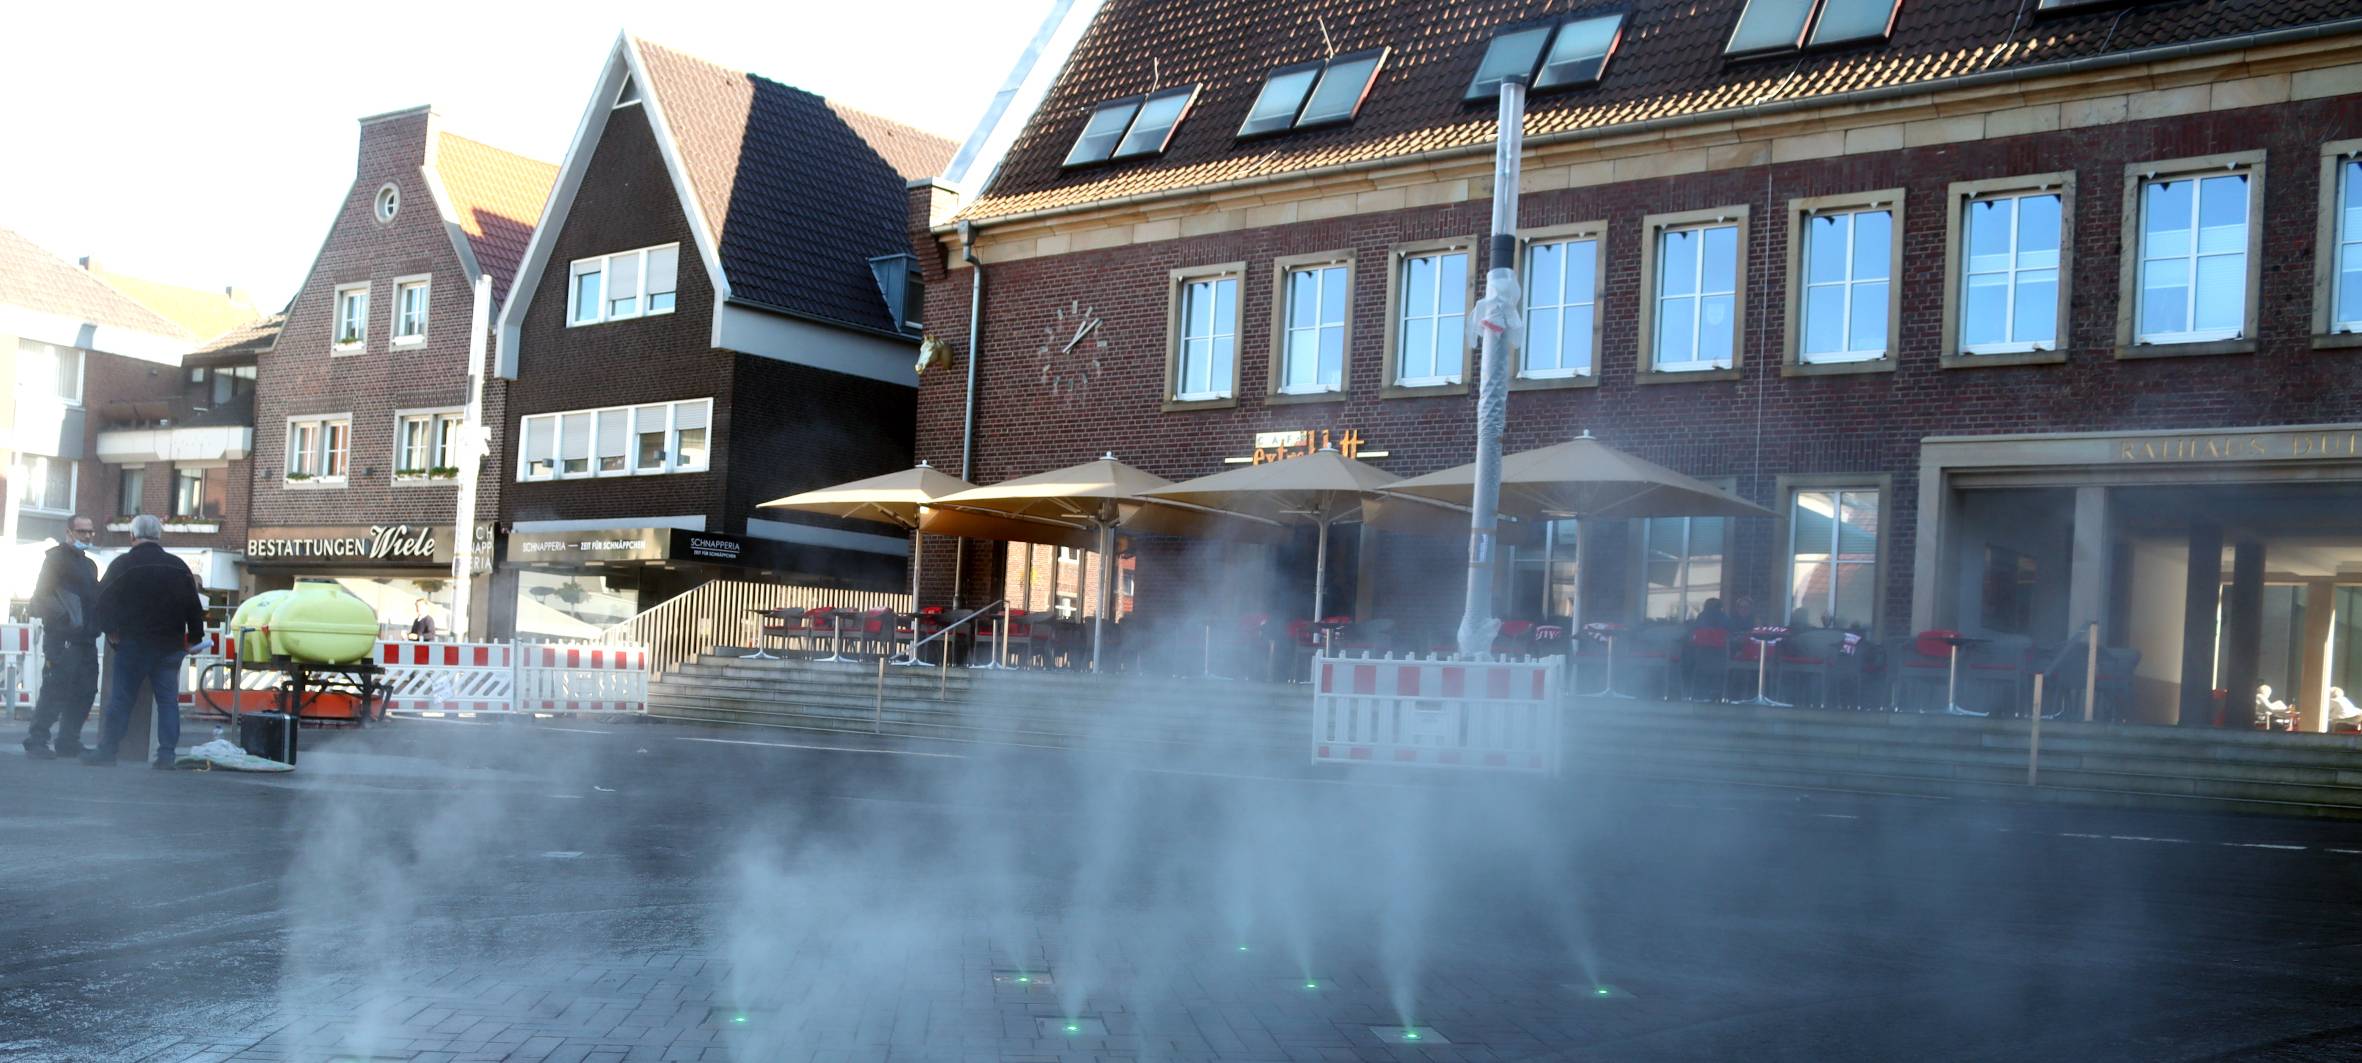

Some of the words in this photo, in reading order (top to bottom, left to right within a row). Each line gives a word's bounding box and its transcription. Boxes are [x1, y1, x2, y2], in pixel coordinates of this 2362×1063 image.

[248, 539, 365, 556] BESTATTUNGEN
[370, 525, 435, 559] Wiele
[523, 541, 566, 552] SCHNAPPERIA
[581, 541, 591, 551] ZEIT
[690, 538, 740, 551] SCHNAPPERIA
